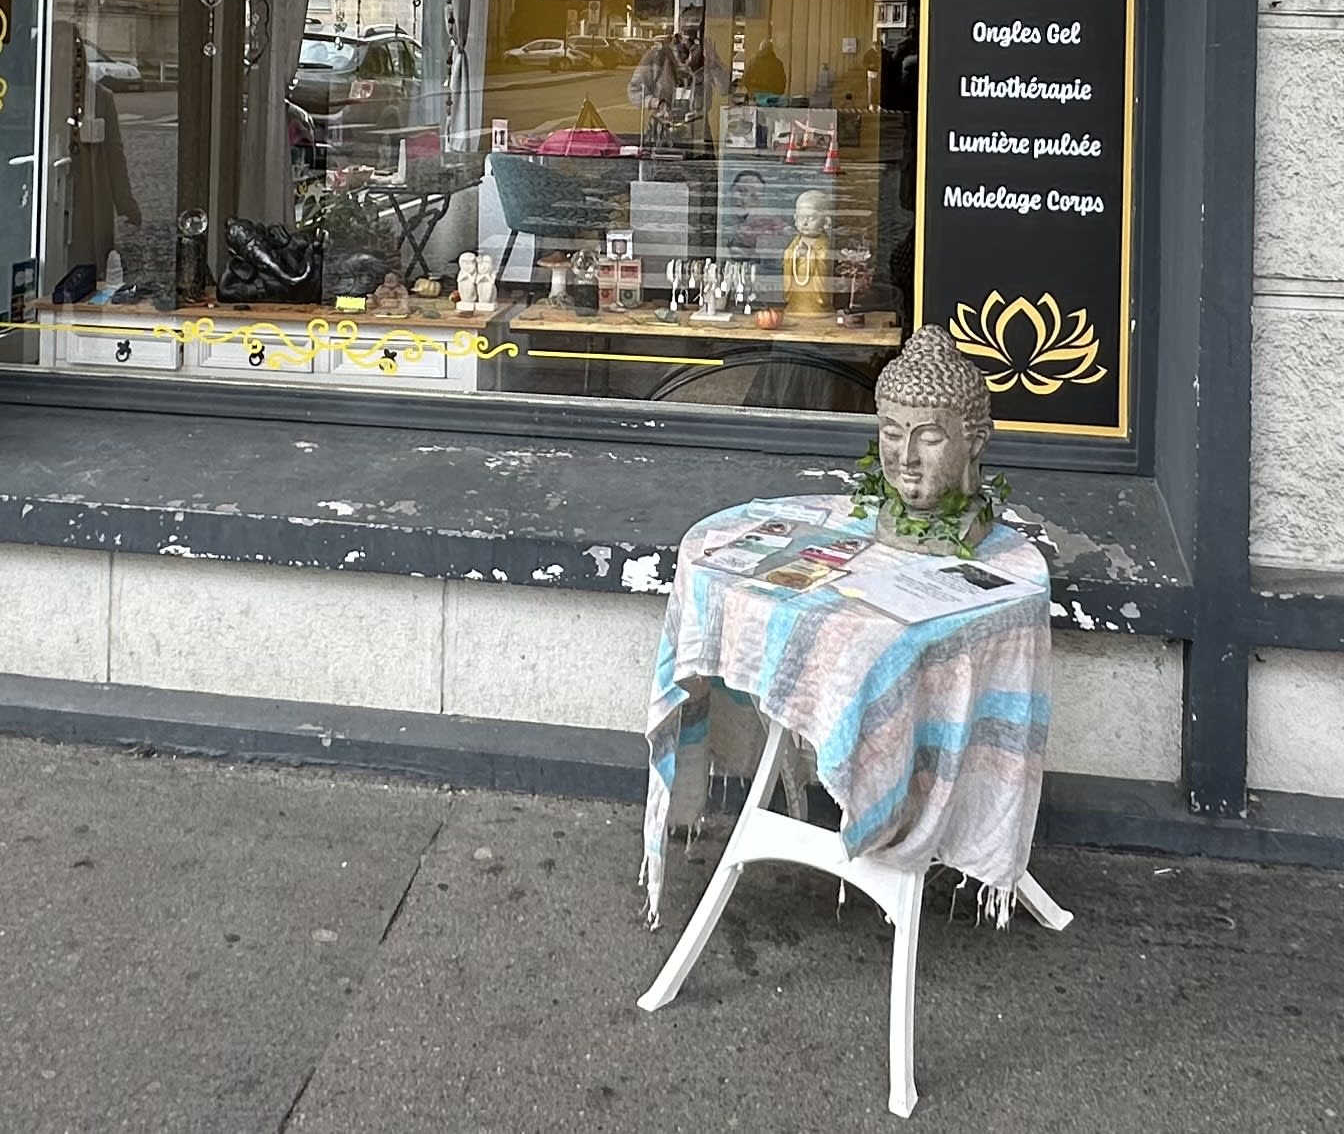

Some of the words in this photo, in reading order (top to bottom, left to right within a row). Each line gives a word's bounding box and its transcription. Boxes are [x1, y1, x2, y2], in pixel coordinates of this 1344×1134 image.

[972, 20, 1042, 47] Ongles
[1046, 22, 1081, 44] Gel
[960, 75, 1092, 103] Lithothérapie
[949, 130, 1029, 154] Lumière
[1033, 133, 1102, 158] pulsée
[944, 185, 1042, 214] Modelage
[1047, 191, 1104, 216] Corps
